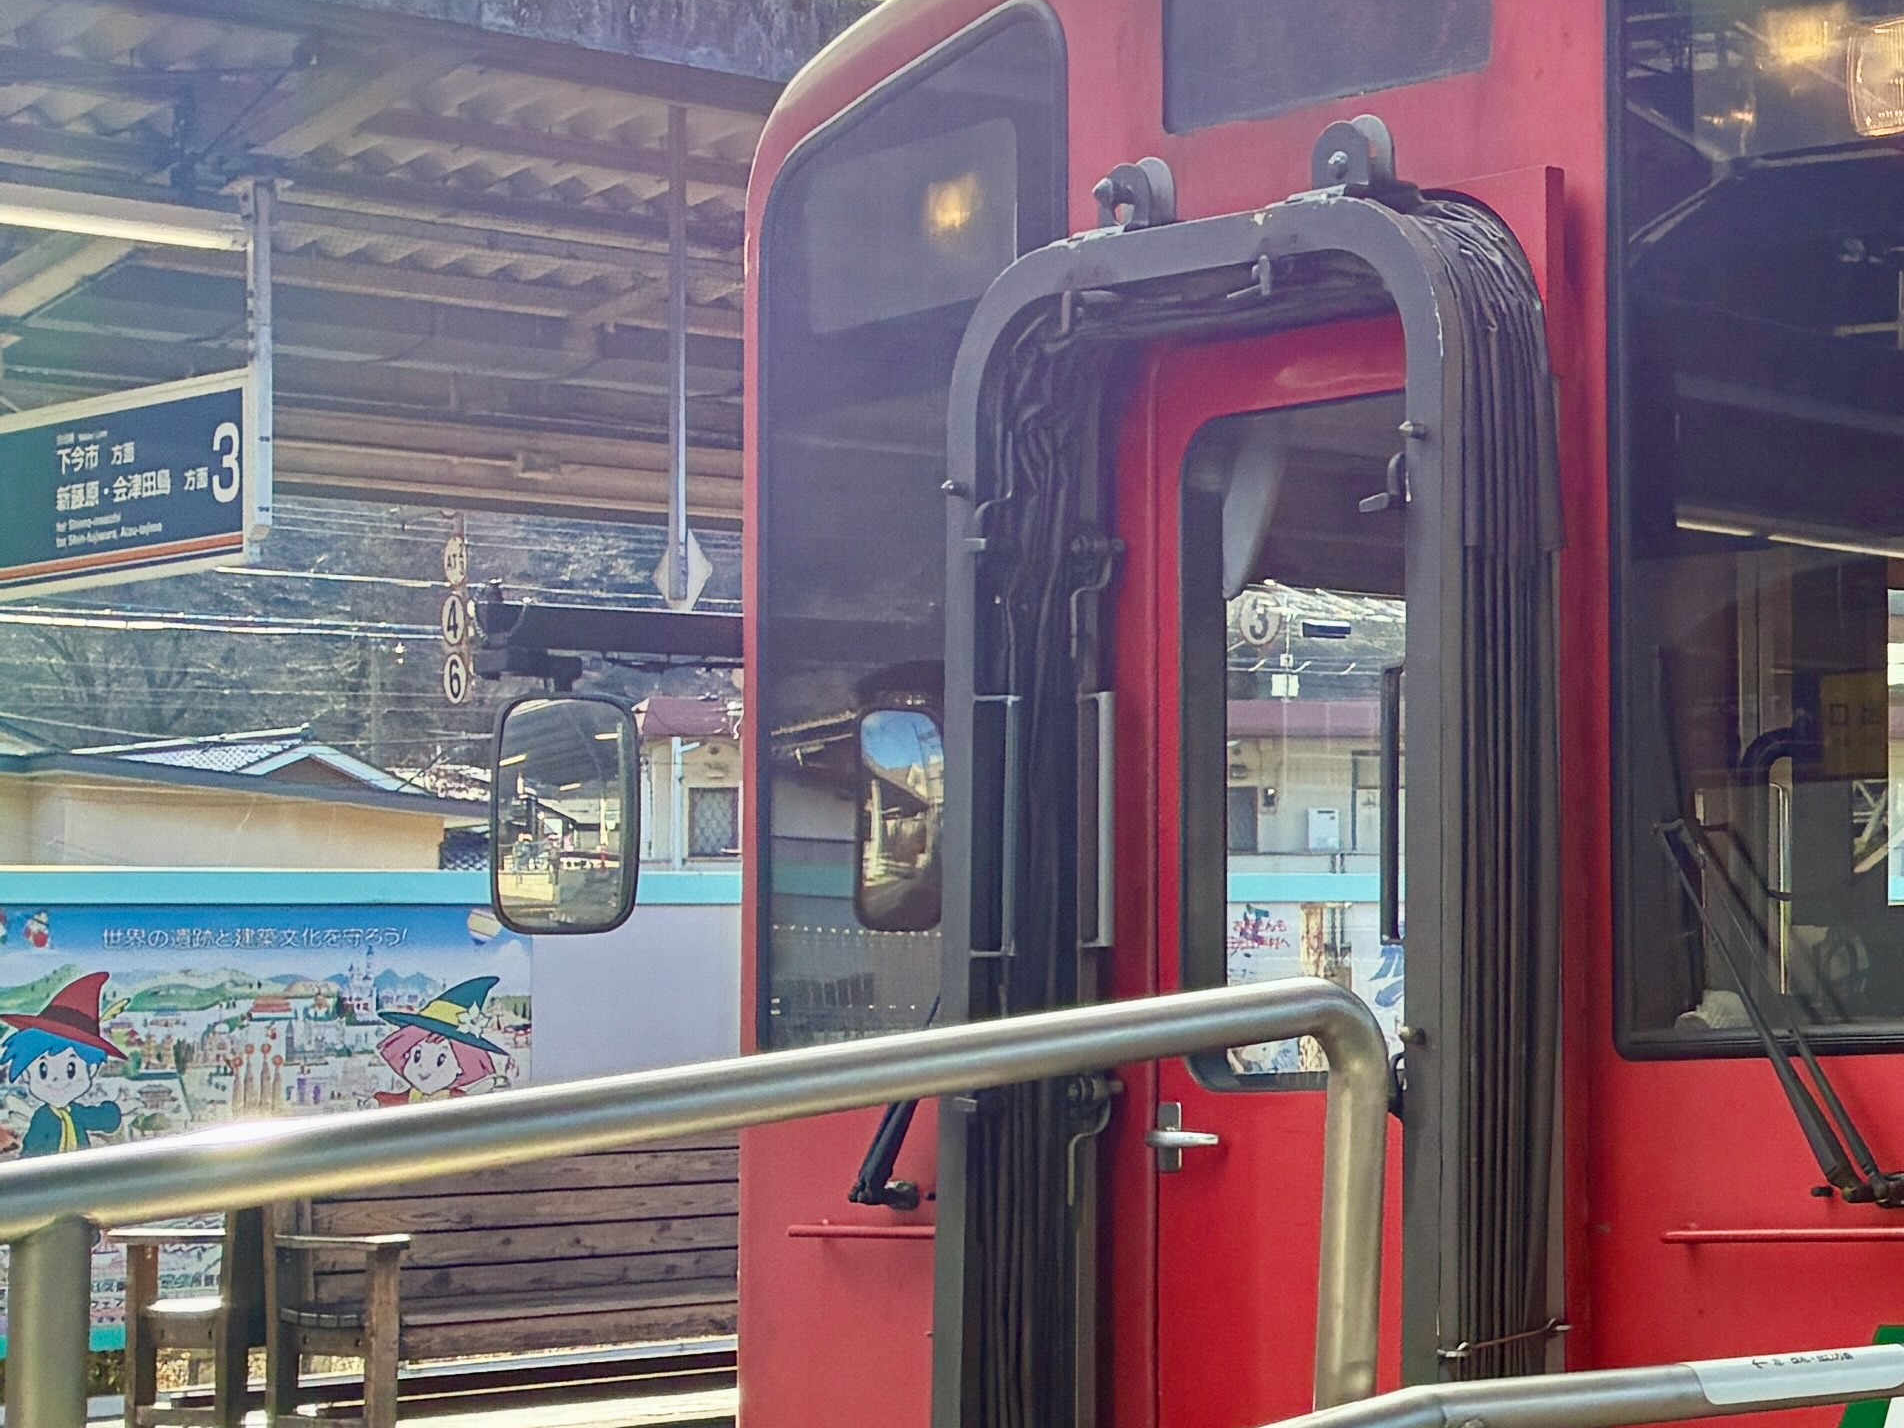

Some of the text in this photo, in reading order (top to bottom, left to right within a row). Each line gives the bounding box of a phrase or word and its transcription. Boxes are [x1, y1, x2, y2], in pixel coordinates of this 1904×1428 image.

[57, 444, 99, 475] 下今市
[212, 422, 240, 503] 3
[446, 601, 458, 639] 4
[450, 659, 461, 699] 6
